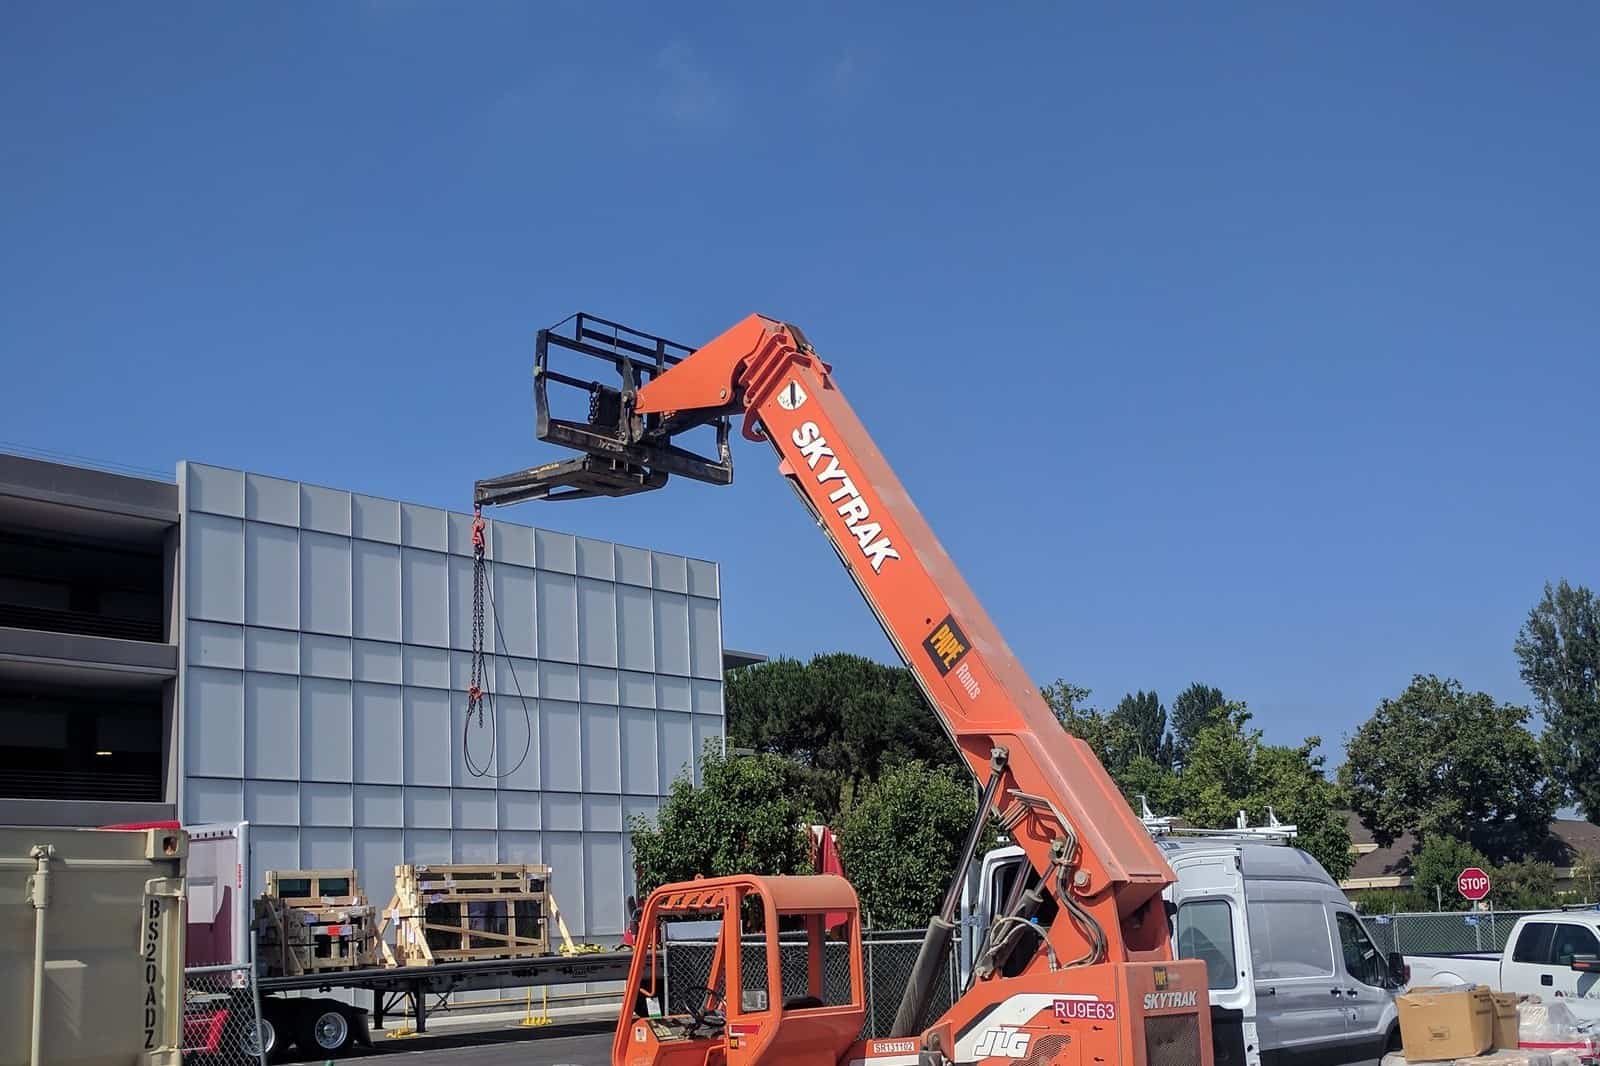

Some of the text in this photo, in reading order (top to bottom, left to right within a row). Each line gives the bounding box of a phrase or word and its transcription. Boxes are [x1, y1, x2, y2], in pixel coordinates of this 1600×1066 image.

[792, 421, 900, 575] SKYTRAK
[956, 662, 981, 699] Rents
[1460, 877, 1487, 890] STOP
[1055, 1001, 1115, 1019] RU9E63
[1144, 991, 1198, 1009] SKYTRAK
[973, 1030, 1032, 1058] JLG
